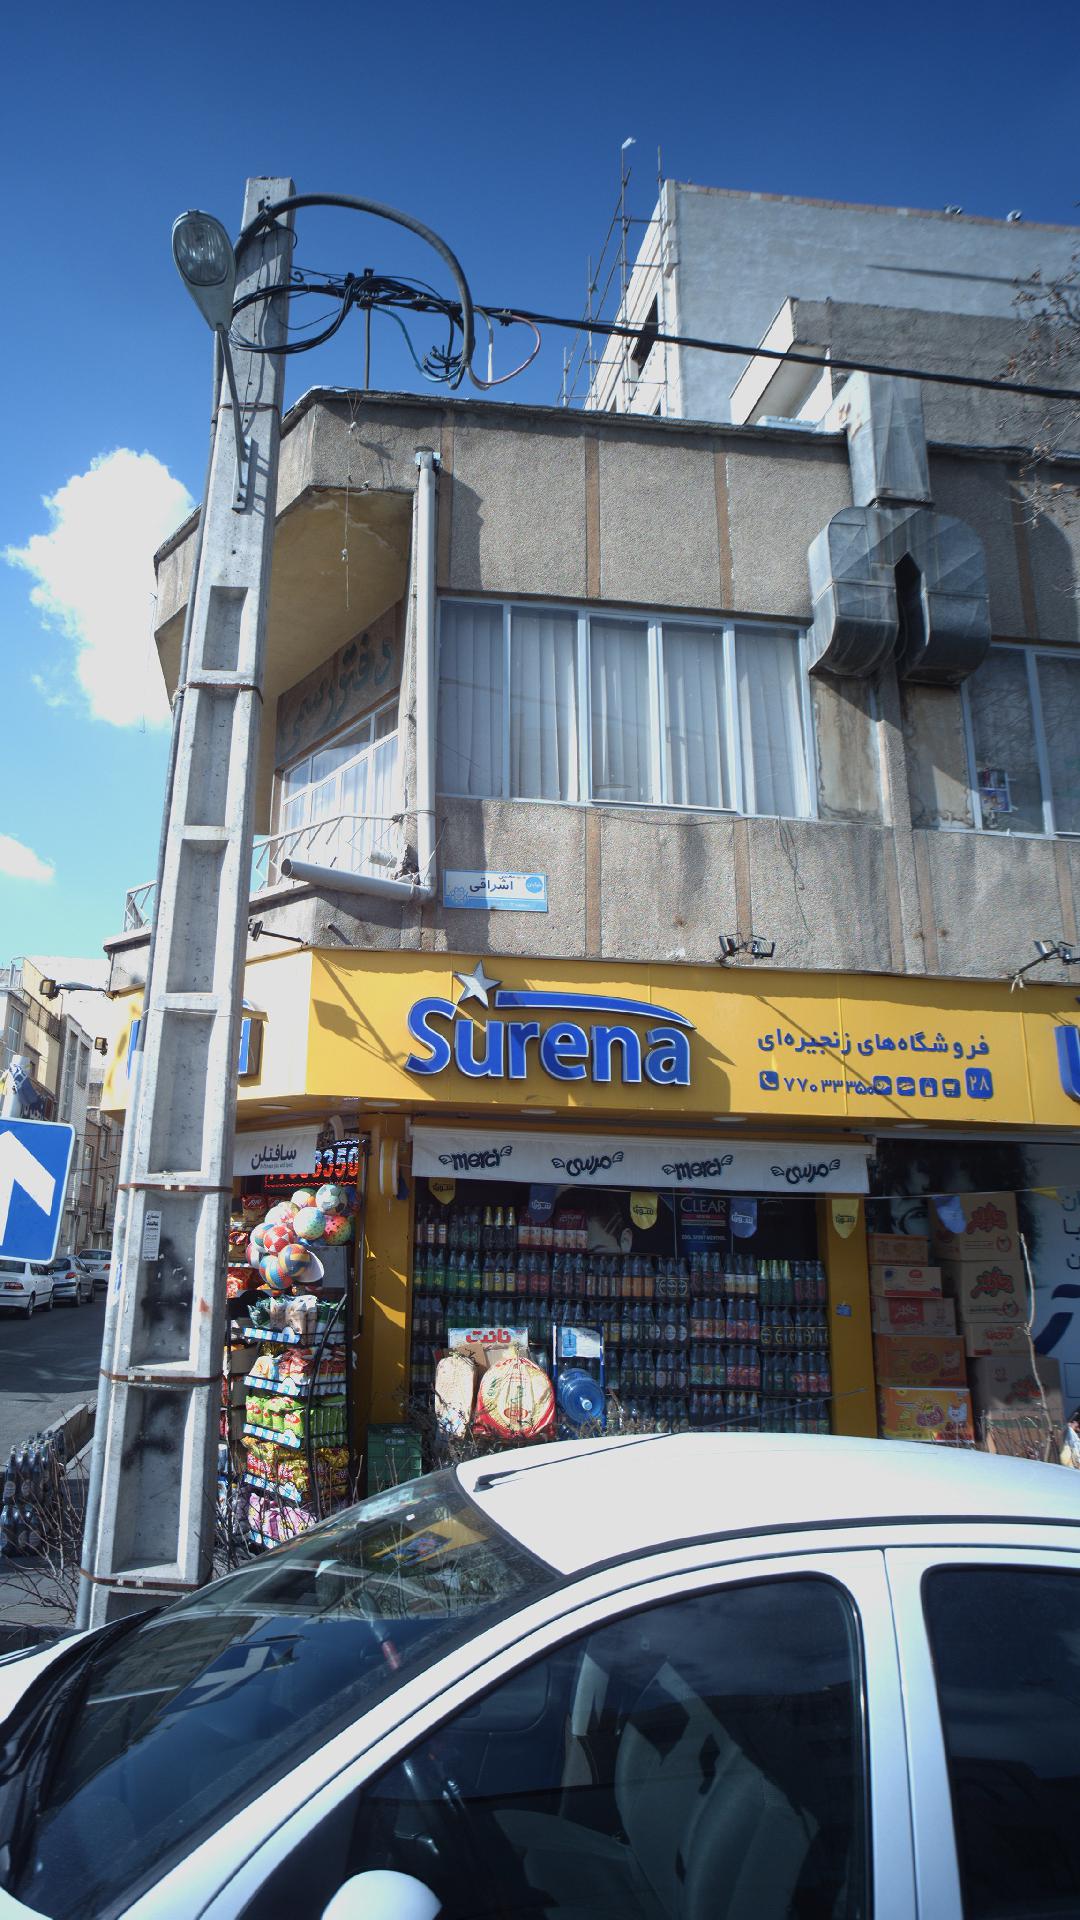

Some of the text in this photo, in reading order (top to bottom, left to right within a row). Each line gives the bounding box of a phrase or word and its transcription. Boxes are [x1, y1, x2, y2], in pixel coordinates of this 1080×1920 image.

[470, 877, 513, 892] اشراقی
[404, 997, 692, 1086] Surena
[251, 1143, 297, 1170] سافتلن
[451, 1149, 500, 1170] merci
[566, 1155, 612, 1176] مرسی
[675, 1158, 722, 1180] merci
[786, 1163, 829, 1184] مرسی
[680, 1196, 727, 1213] CLEAR
